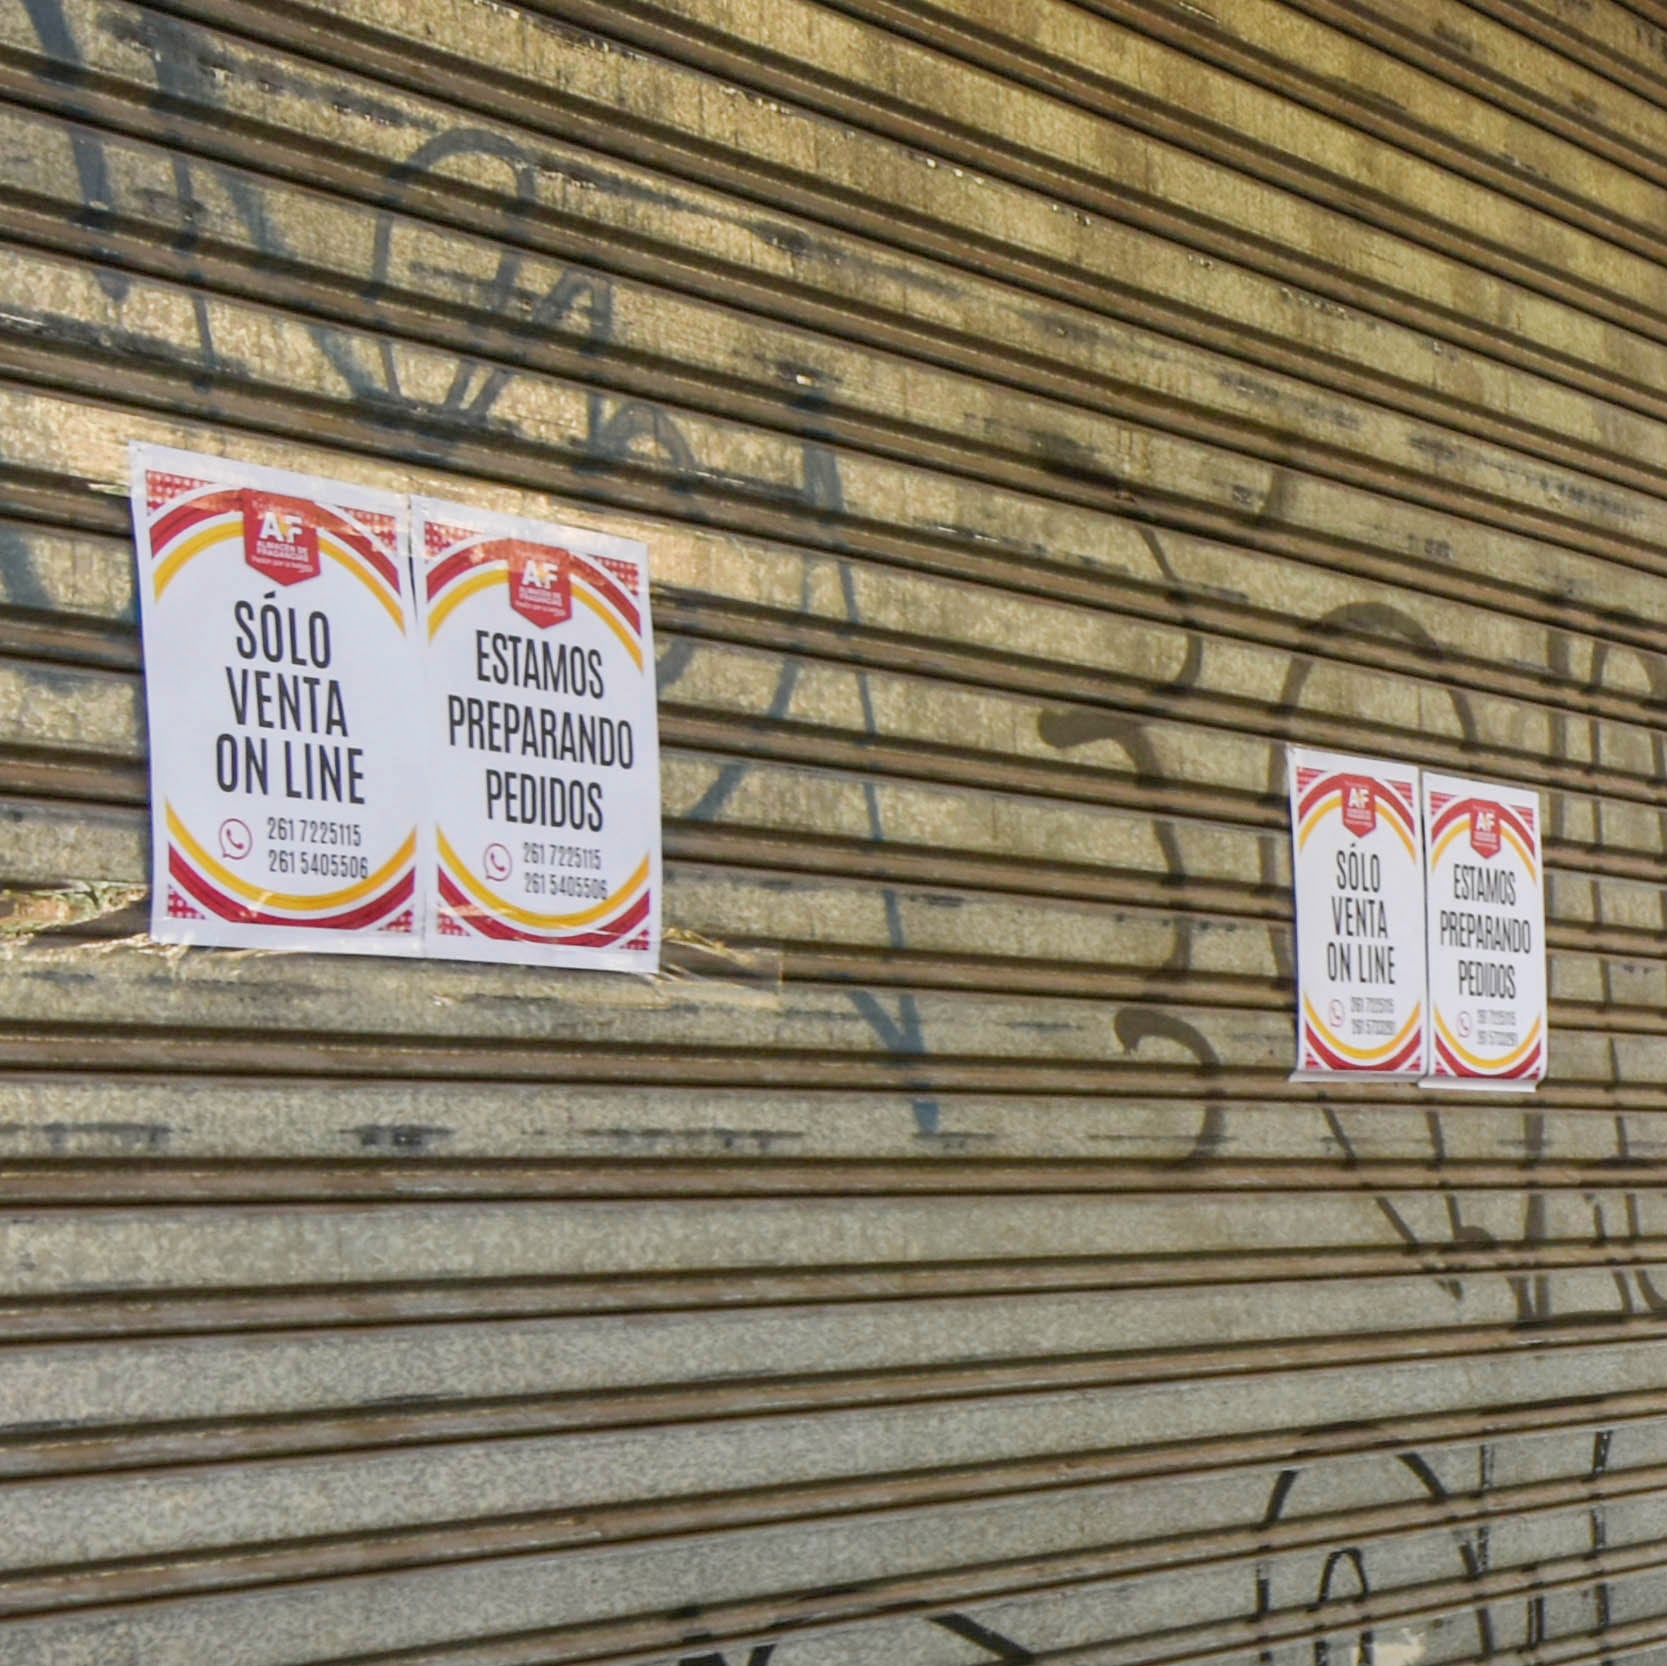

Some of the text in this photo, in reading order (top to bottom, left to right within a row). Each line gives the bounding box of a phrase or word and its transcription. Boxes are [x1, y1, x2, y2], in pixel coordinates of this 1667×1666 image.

[259, 510, 304, 544] AF
[521, 558, 559, 590] AF
[234, 590, 332, 669] SÓLO
[475, 629, 605, 700] ESTAMOS
[225, 665, 349, 738] VENTA
[447, 693, 634, 770] PREPARANDO
[216, 732, 366, 805] ON LINE
[485, 768, 604, 833] PEDIDOS
[267, 816, 362, 847] 261 7225115
[268, 848, 368, 880] 261 5405506
[522, 841, 603, 871] 261 7225115
[1336, 842, 1381, 893] SÓLO
[523, 871, 547, 895] 261
[1453, 864, 1517, 906] ESTAMOS
[1331, 896, 1389, 939] VENTA
[1440, 909, 1531, 955] PREPARANDO
[1327, 941, 1396, 985] ON LINE
[1458, 959, 1517, 999] PEDIDOS
